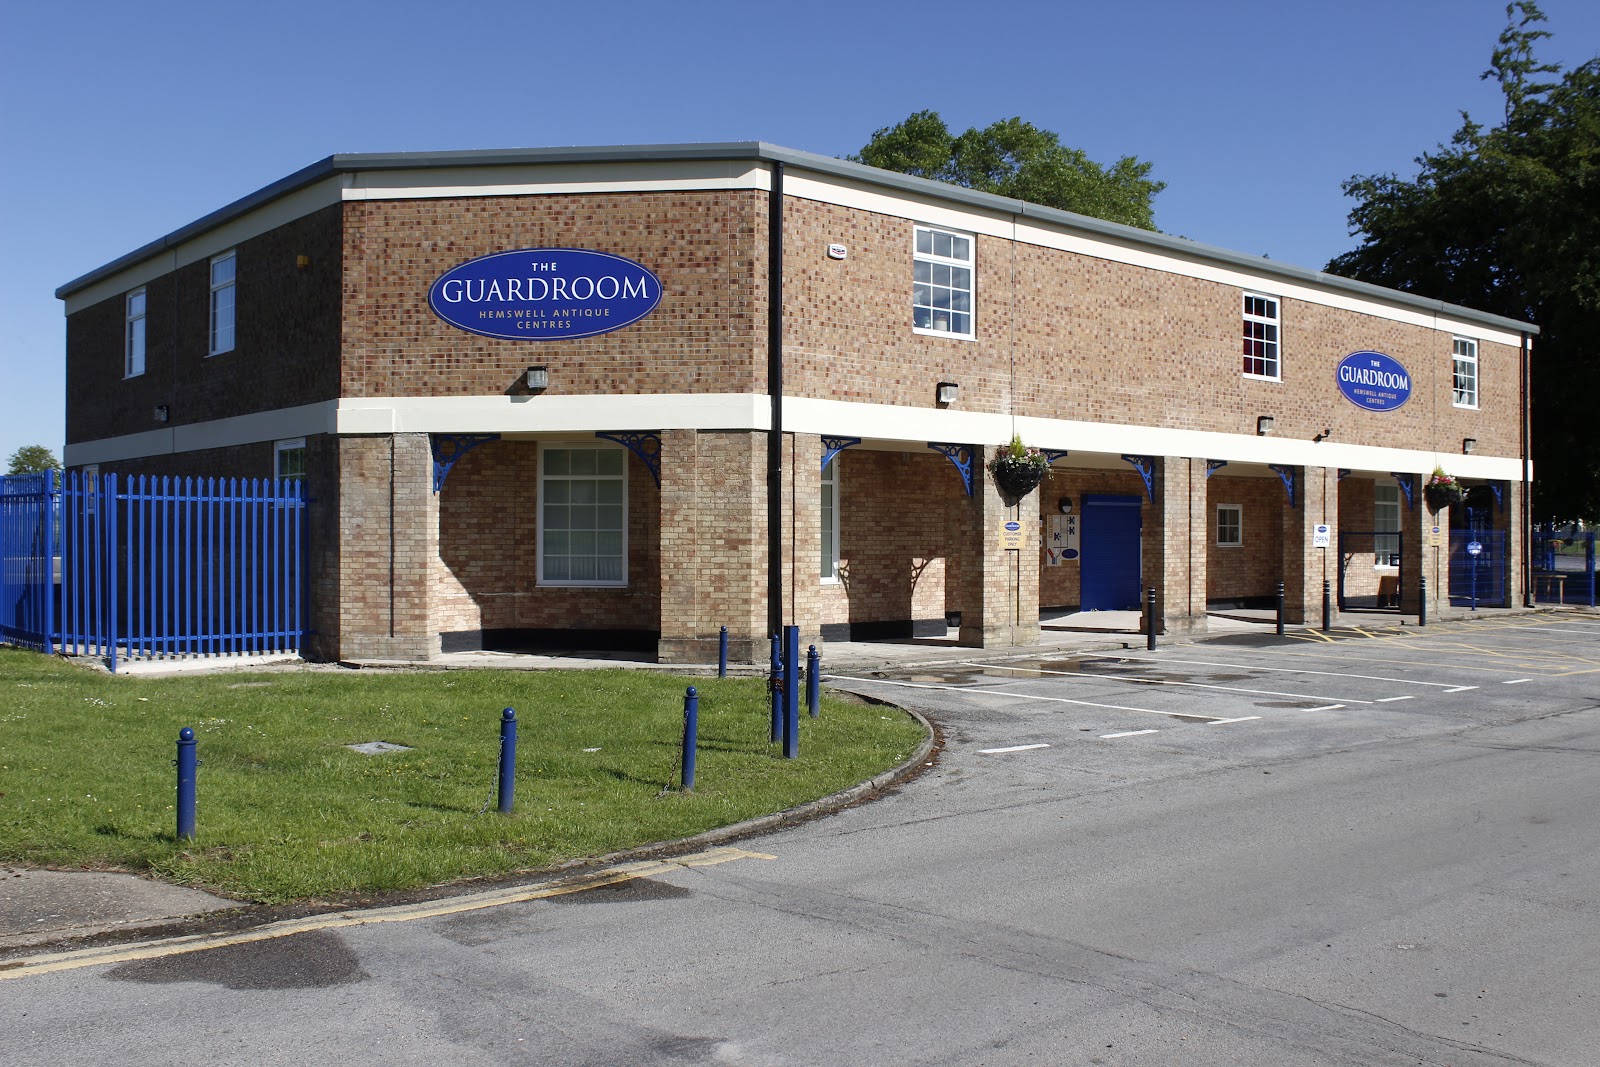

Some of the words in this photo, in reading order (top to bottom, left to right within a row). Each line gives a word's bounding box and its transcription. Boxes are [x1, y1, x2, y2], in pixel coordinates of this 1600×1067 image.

[531, 262, 558, 272] THE
[441, 275, 650, 304] GUARDROOM
[479, 309, 546, 319] HEMSWELL
[553, 308, 610, 318] ANTIQUE
[516, 320, 572, 330] CENTRES
[1340, 366, 1408, 390] GUARDROOM
